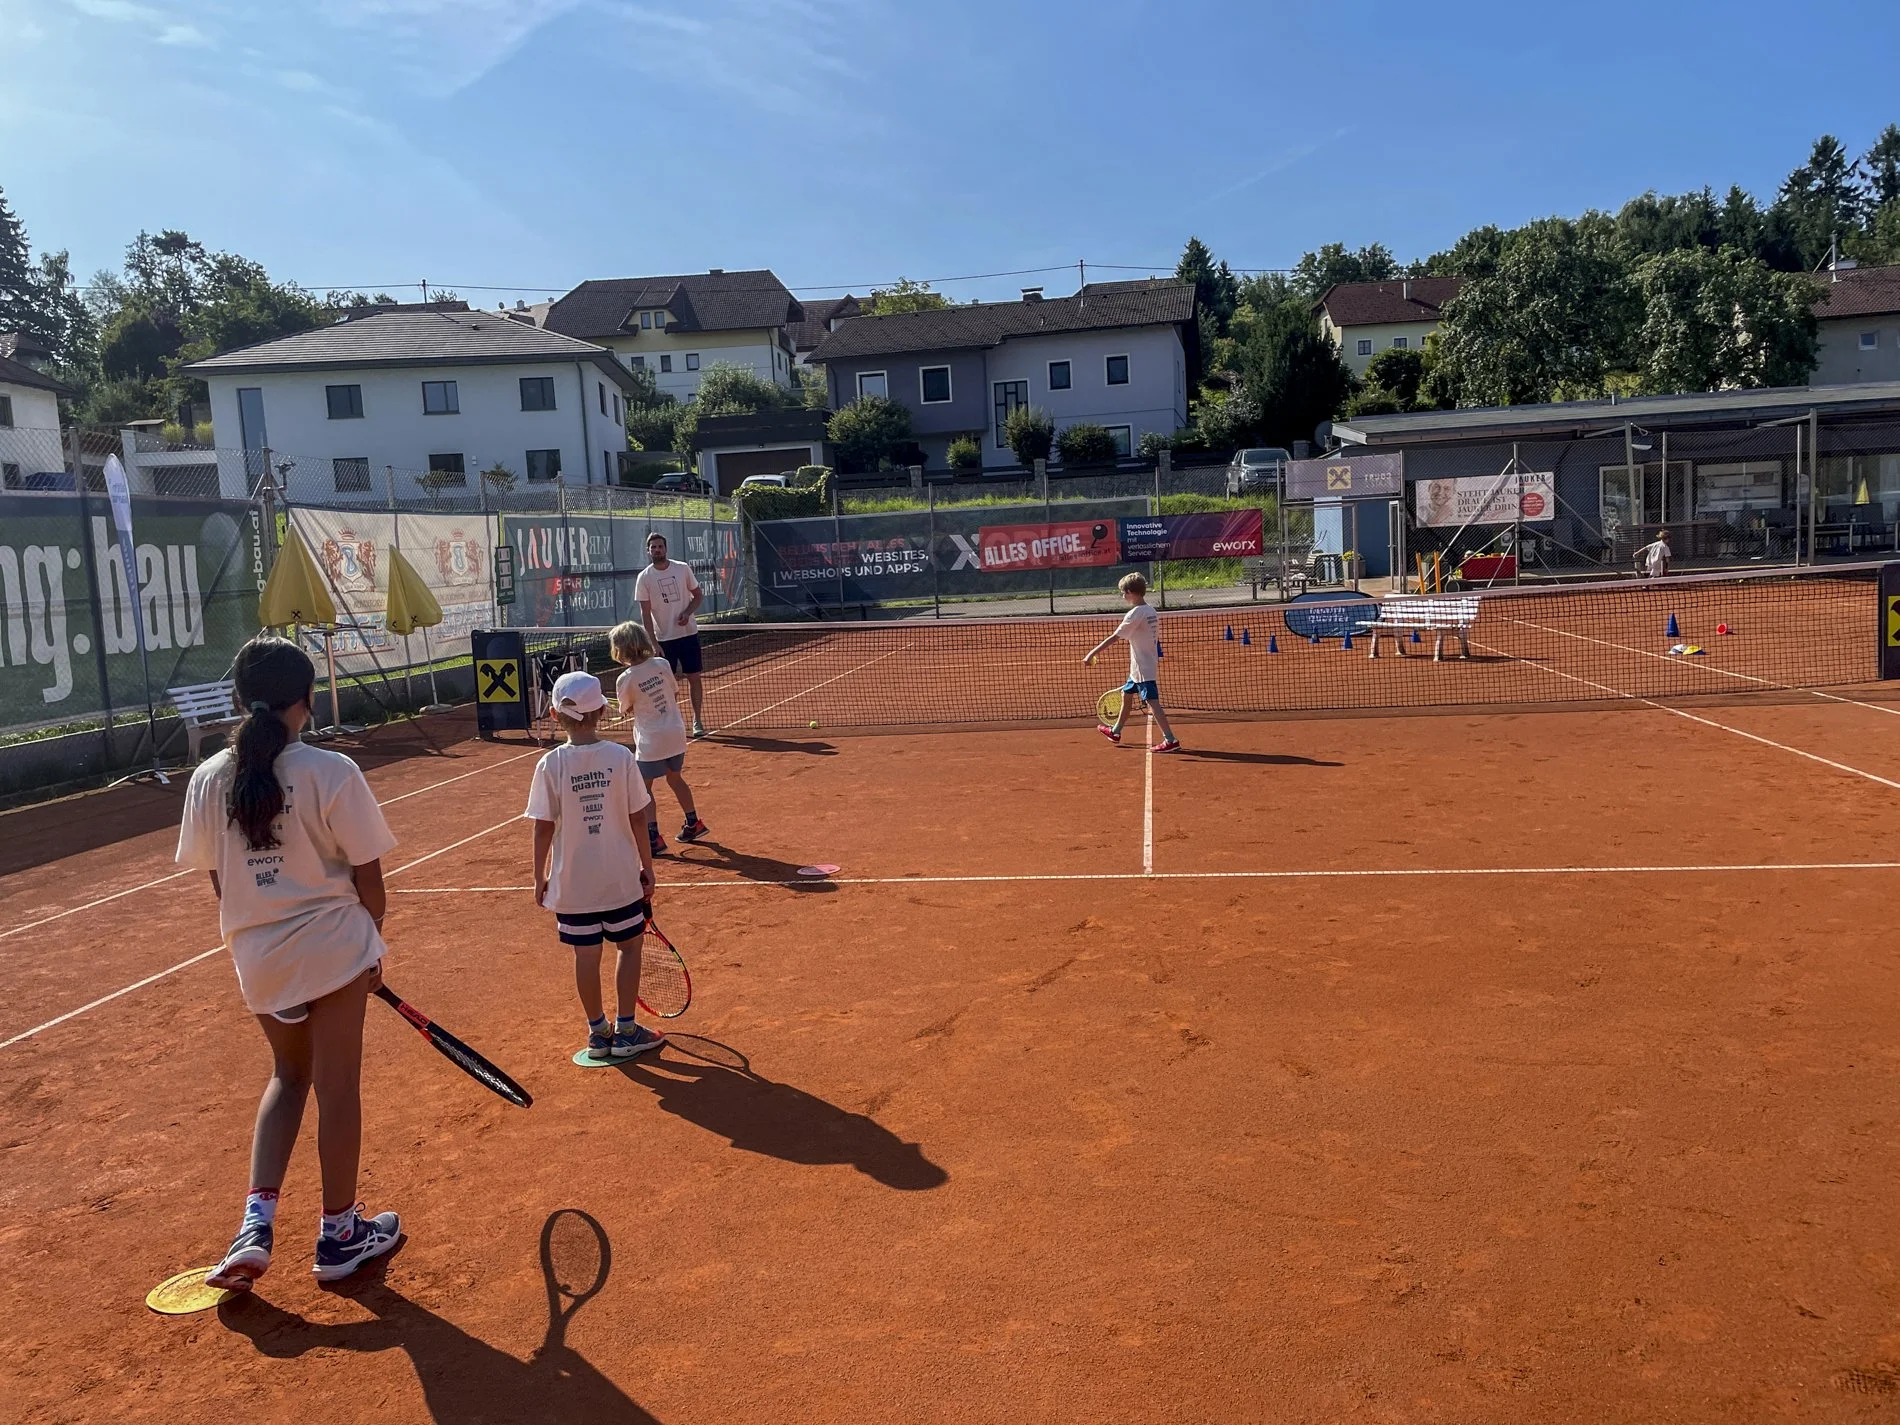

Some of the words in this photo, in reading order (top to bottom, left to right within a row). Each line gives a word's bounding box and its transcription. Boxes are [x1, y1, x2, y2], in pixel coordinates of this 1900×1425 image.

[1126, 522, 1163, 530] Innovative
[1127, 529, 1168, 537] Technologie
[984, 542, 1027, 567] ALLES
[1031, 533, 1086, 559] OFFICE.
[1213, 540, 1256, 552] eworx
[861, 549, 929, 563] WEBSITES,
[780, 565, 851, 581] WEBSHOPS
[854, 564, 883, 577] UND
[885, 562, 923, 575] APPS.
[571, 771, 605, 784] health
[572, 780, 611, 793] quarter
[247, 855, 285, 866] eworx
